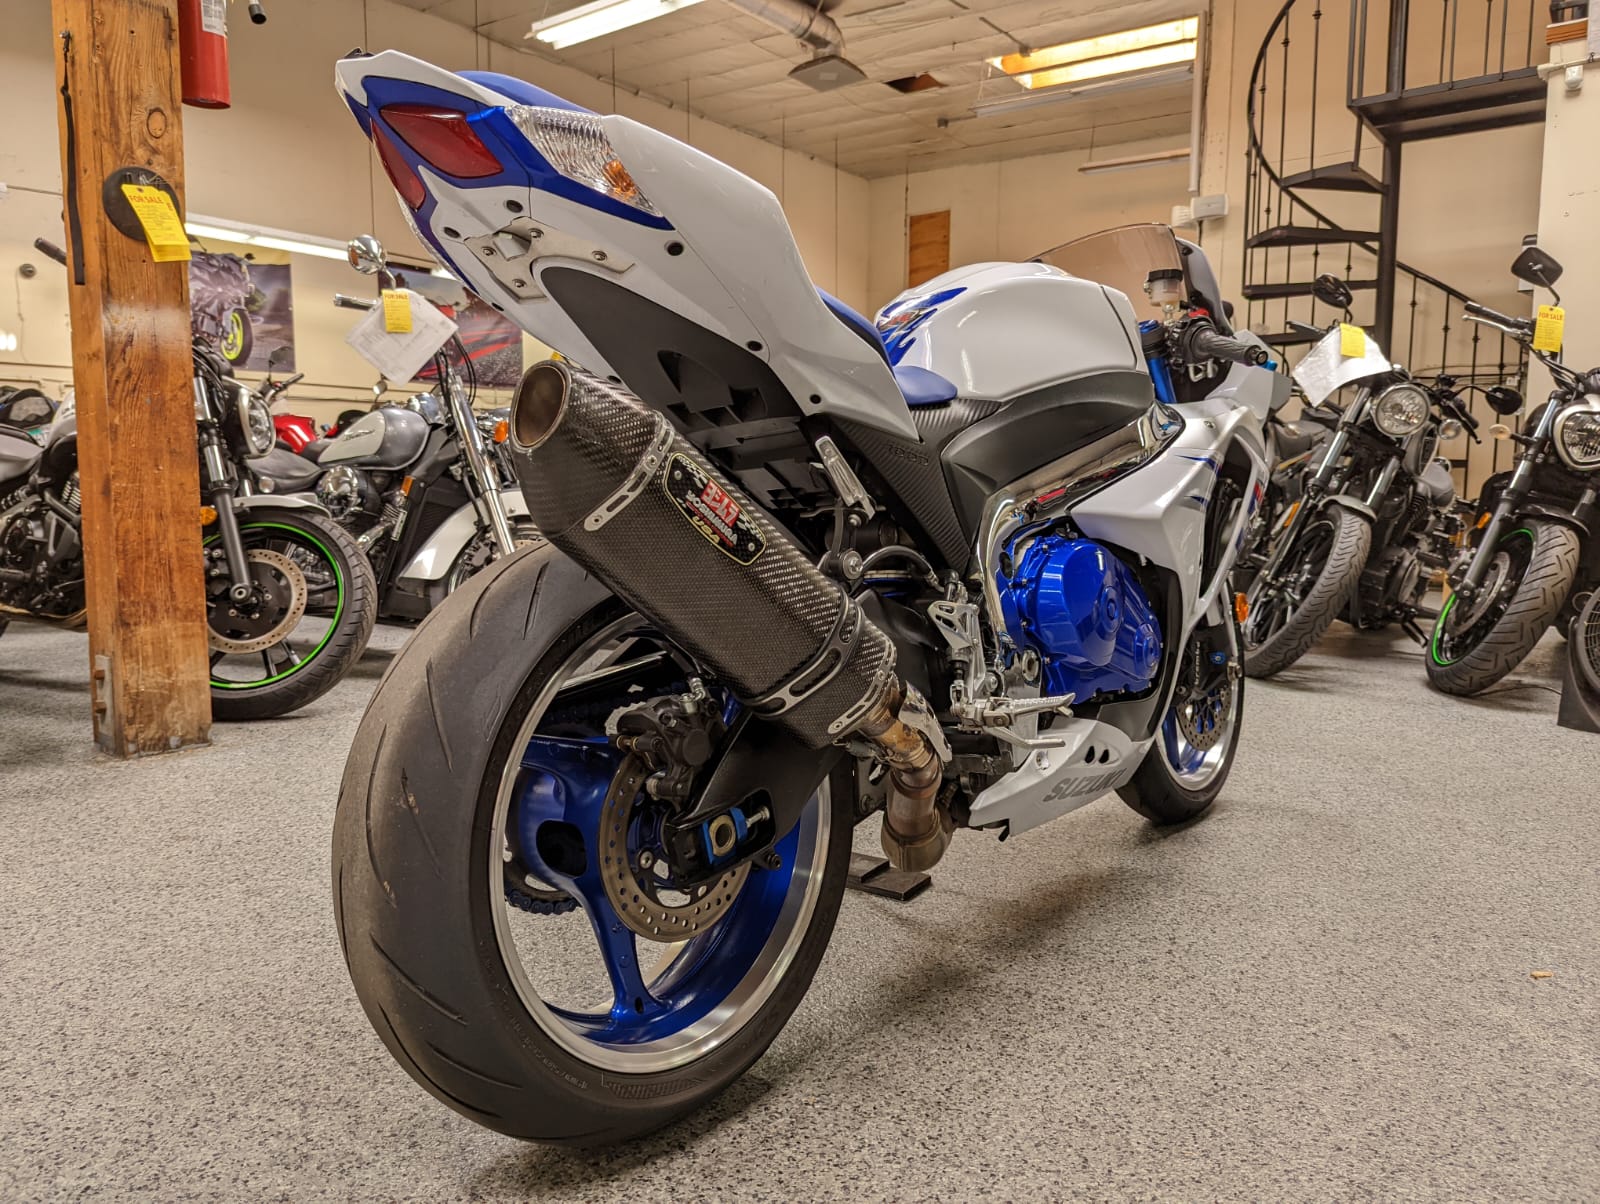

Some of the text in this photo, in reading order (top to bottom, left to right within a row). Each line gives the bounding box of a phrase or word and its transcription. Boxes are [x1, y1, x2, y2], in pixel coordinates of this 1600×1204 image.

[144, 196, 164, 204] SALE
[1550, 313, 1562, 321] SALE
[685, 489, 738, 545] YOSHIMURA
[691, 515, 720, 544] USA
